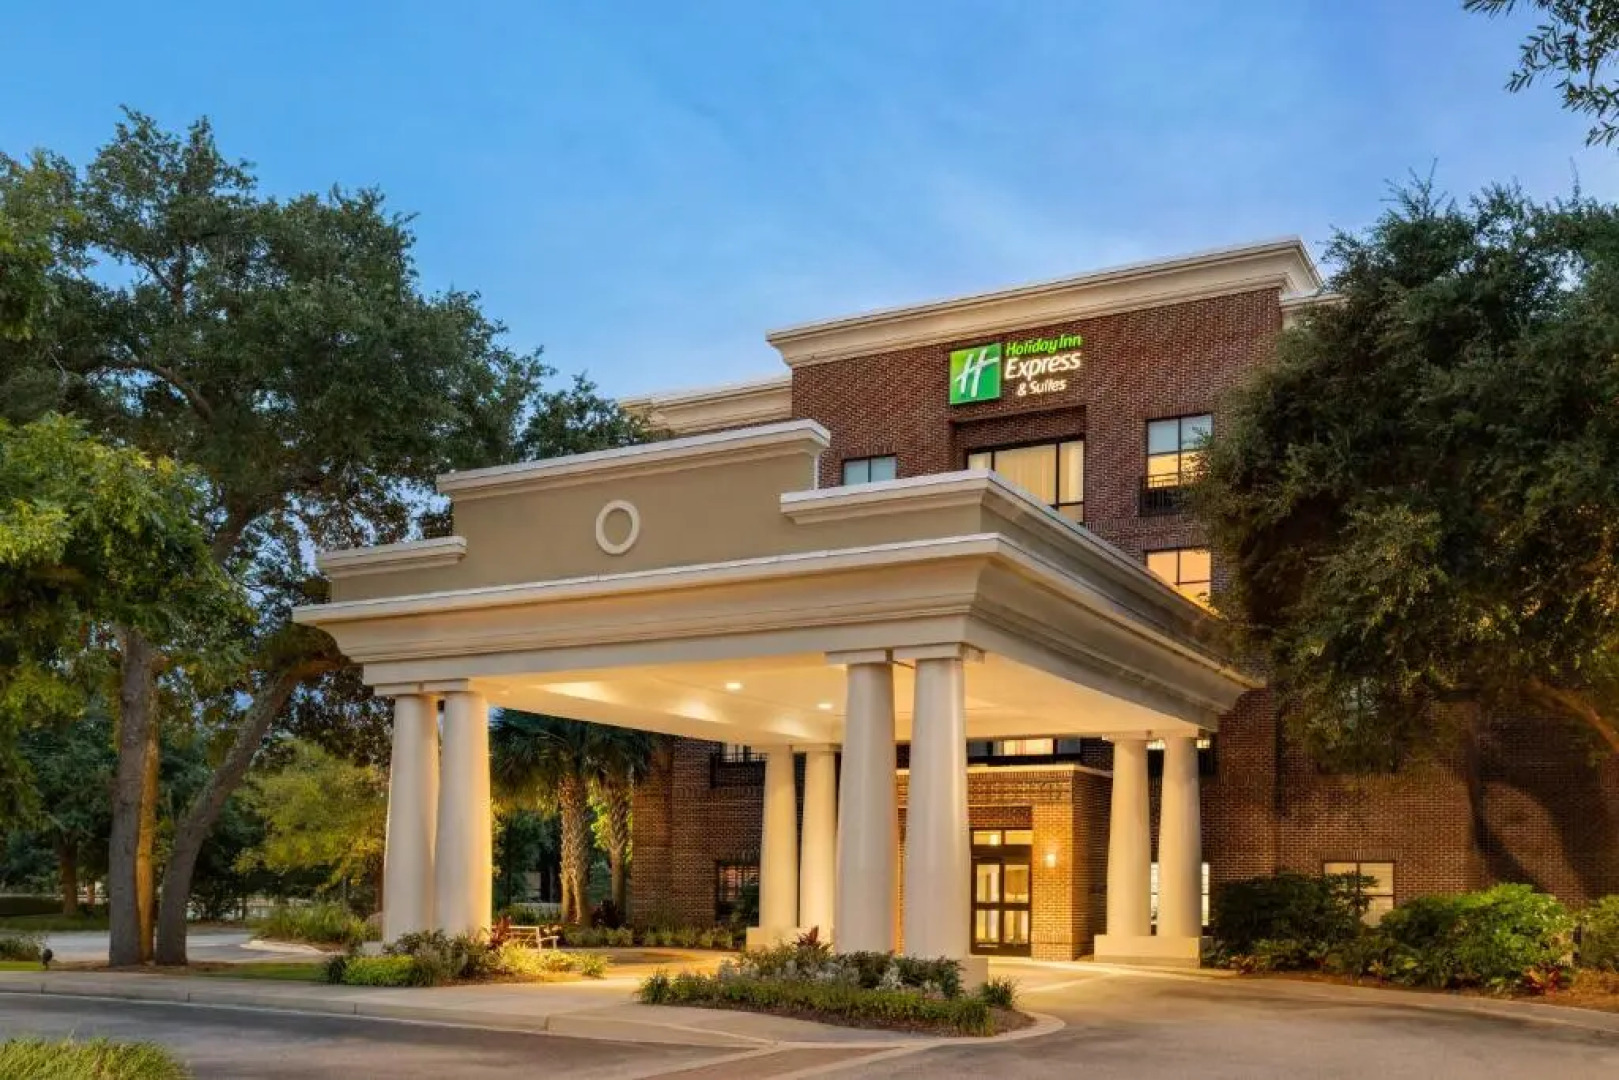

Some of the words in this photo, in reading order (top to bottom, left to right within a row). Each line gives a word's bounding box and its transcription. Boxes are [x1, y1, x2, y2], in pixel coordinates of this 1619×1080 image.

[1006, 337, 1057, 356] Holiday
[1059, 333, 1082, 349] Inn
[1004, 351, 1082, 381] Express
[1017, 382, 1027, 397] &
[1030, 378, 1067, 394] Suites
